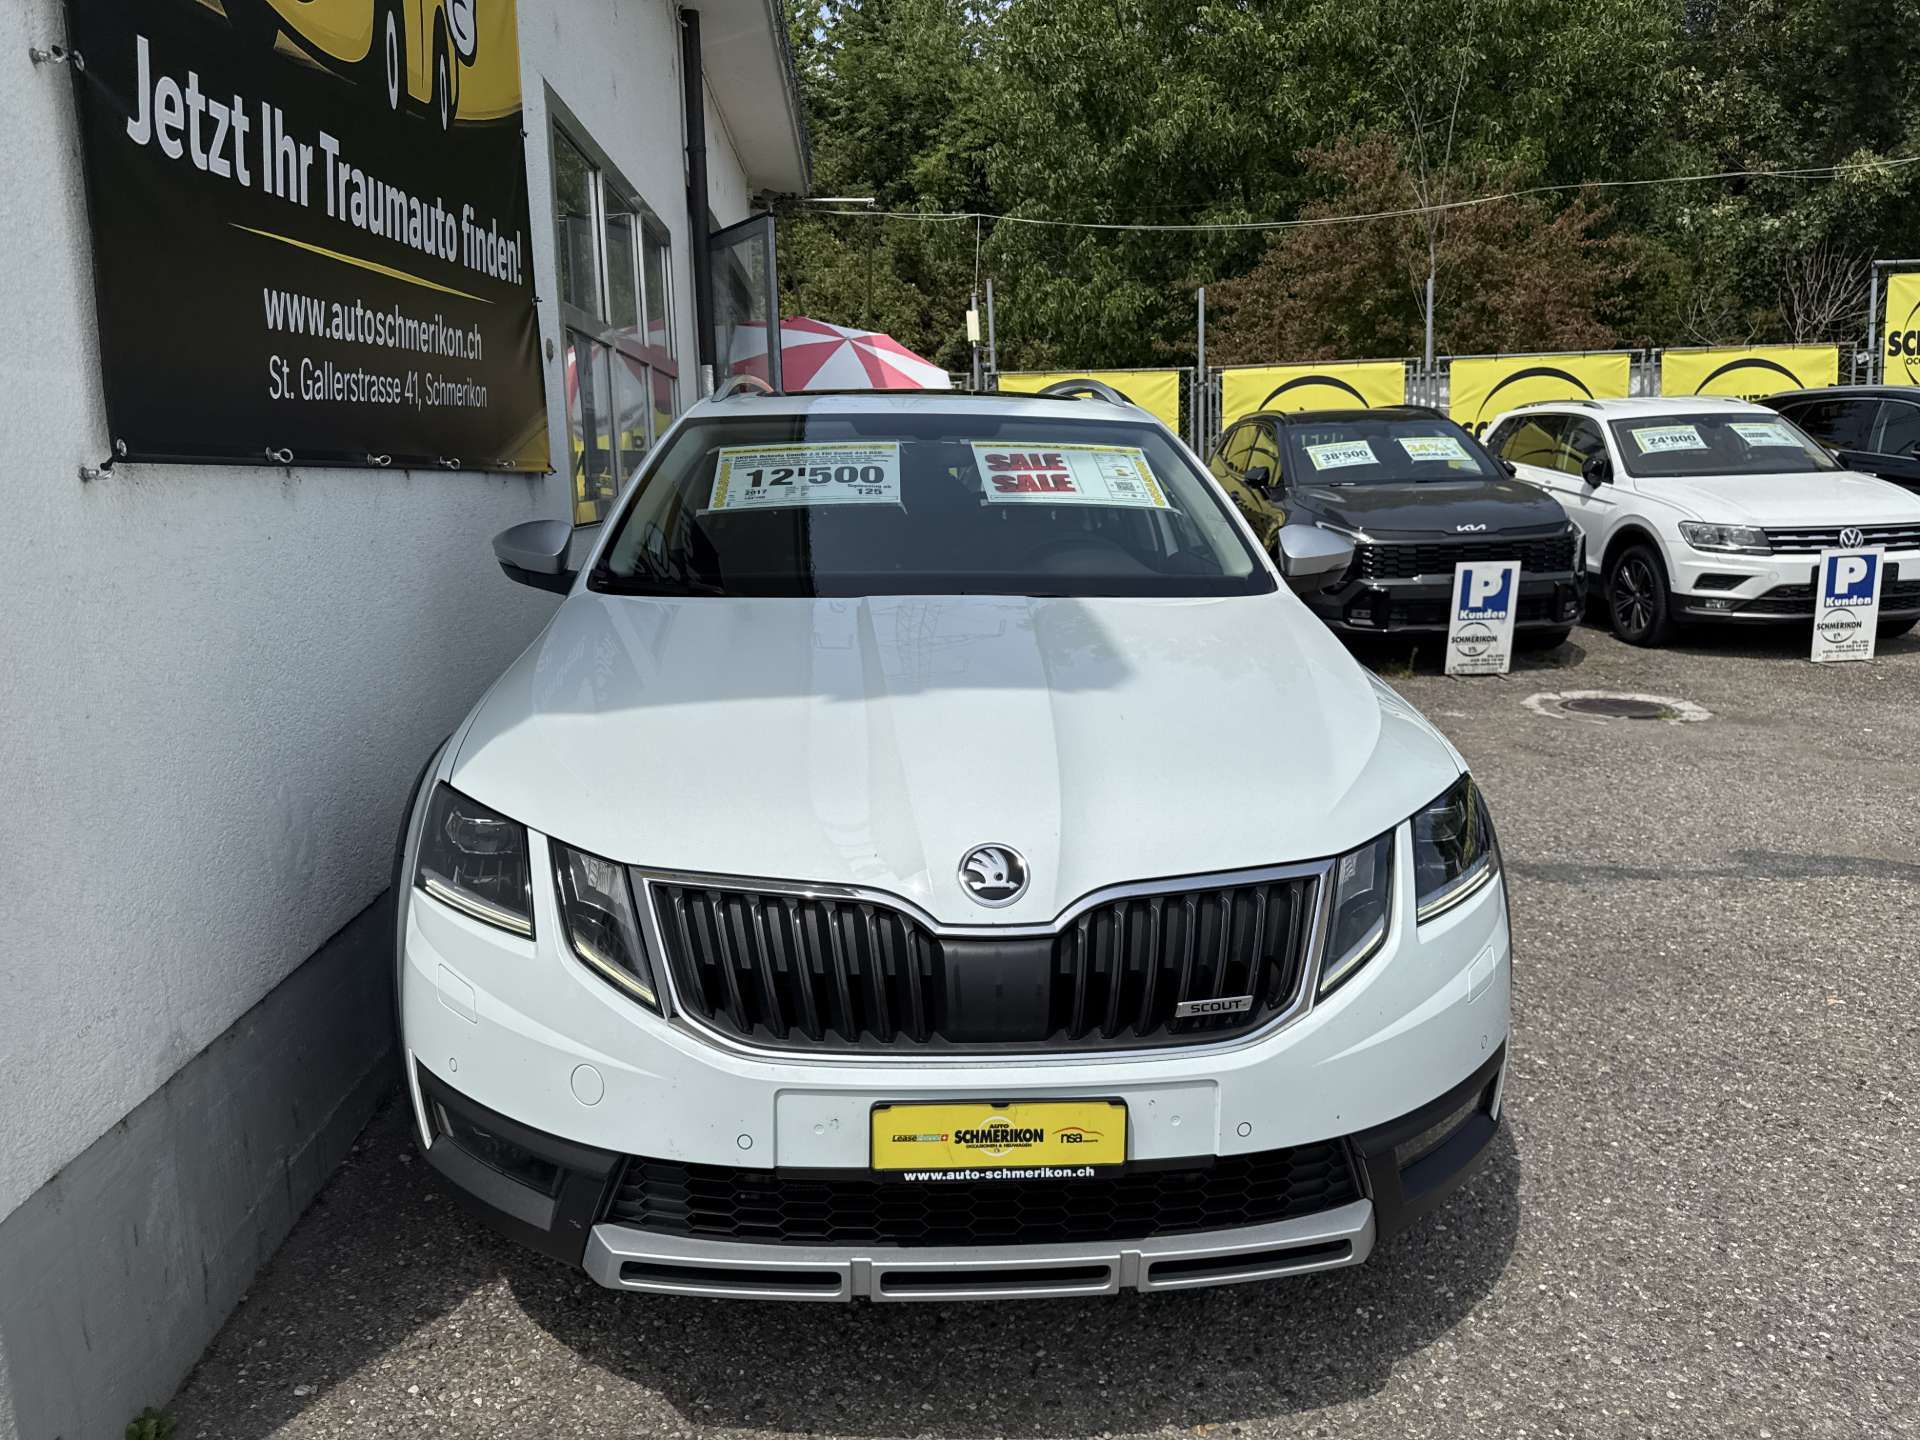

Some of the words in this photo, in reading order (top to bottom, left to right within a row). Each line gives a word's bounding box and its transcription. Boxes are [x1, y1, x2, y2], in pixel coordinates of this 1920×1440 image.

[127, 34, 250, 187] Jetzt
[262, 101, 314, 207] Ihr
[319, 131, 457, 262] Traumauto
[461, 204, 522, 285] finden!
[264, 287, 482, 360] www.autoschmerikon.ch
[1888, 331, 1920, 356] SC
[269, 354, 294, 400] St.
[300, 357, 401, 404] Gallerstrasse
[405, 370, 422, 412] 41,
[425, 372, 487, 408] Schmerikon
[1648, 435, 1697, 446] 24'800
[985, 453, 1067, 472] SALE
[1321, 449, 1368, 462] 38'500
[746, 466, 885, 488] 12'500
[991, 474, 1076, 493] SALE
[1834, 557, 1868, 595] P
[1468, 567, 1503, 608] P
[1825, 595, 1871, 607] Kunden
[1460, 608, 1506, 620] Kunden
[1816, 621, 1862, 631] SCHMERIKON
[1451, 635, 1498, 644] SCHMERIKON
[1190, 1000, 1242, 1013] SCOUT
[954, 1128, 1044, 1145] SCHMERIKON
[1060, 1133, 1083, 1144] nsa
[904, 1166, 1095, 1182] www.auto-schmerikon.ch
